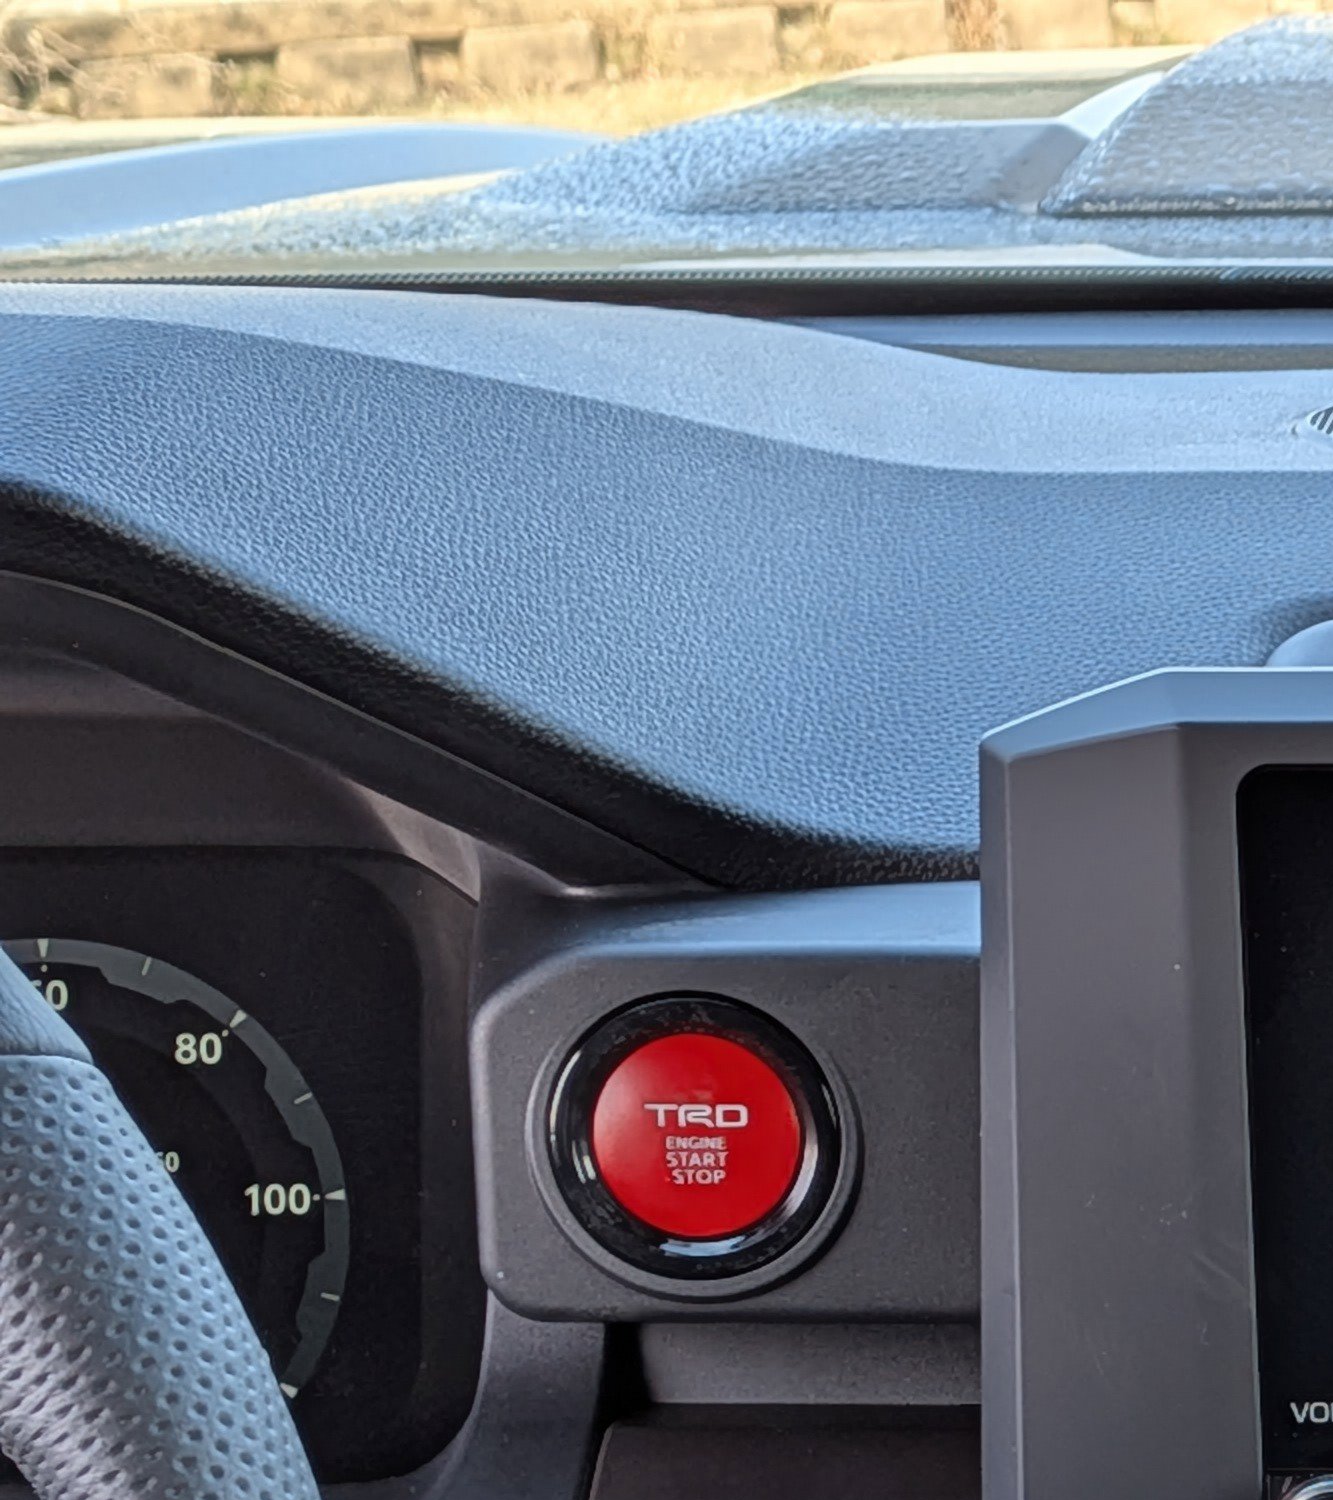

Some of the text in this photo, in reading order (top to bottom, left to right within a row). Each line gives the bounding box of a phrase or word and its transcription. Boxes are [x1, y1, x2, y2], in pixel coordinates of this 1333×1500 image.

[173, 1031, 223, 1066] 80
[643, 1103, 748, 1128] TRD
[665, 1136, 727, 1150] ENGINE
[155, 1150, 180, 1173] 0
[666, 1151, 729, 1168] START
[671, 1169, 727, 1185] STOP
[243, 1183, 312, 1216] 100
